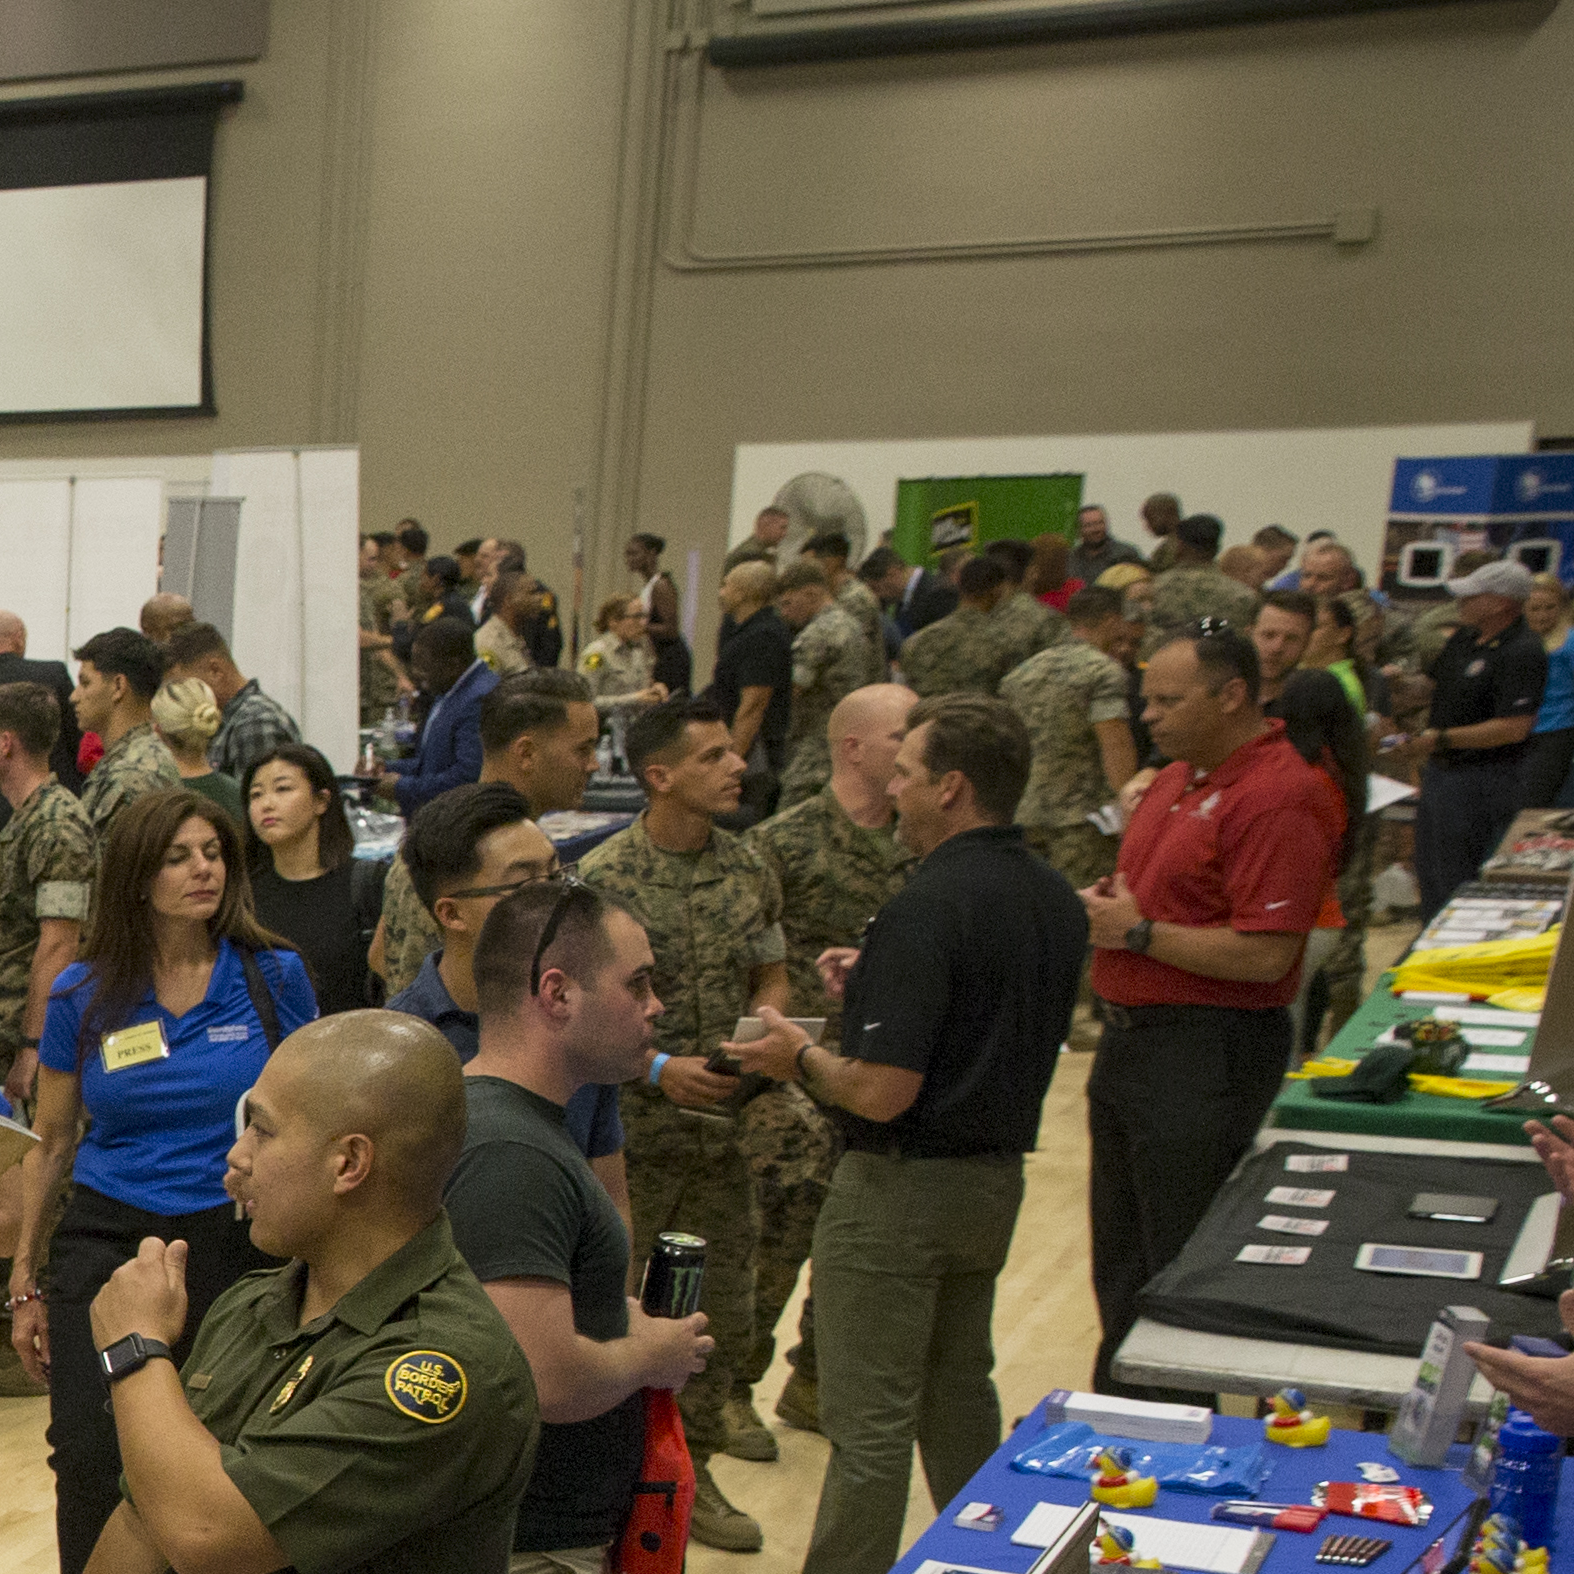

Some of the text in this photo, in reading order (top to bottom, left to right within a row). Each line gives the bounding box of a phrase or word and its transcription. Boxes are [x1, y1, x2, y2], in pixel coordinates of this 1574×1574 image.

[117, 1044, 152, 1059] PRESS
[421, 1361, 445, 1376] U.S.
[400, 1370, 457, 1393] BORDER
[396, 1380, 449, 1410] PATROL
